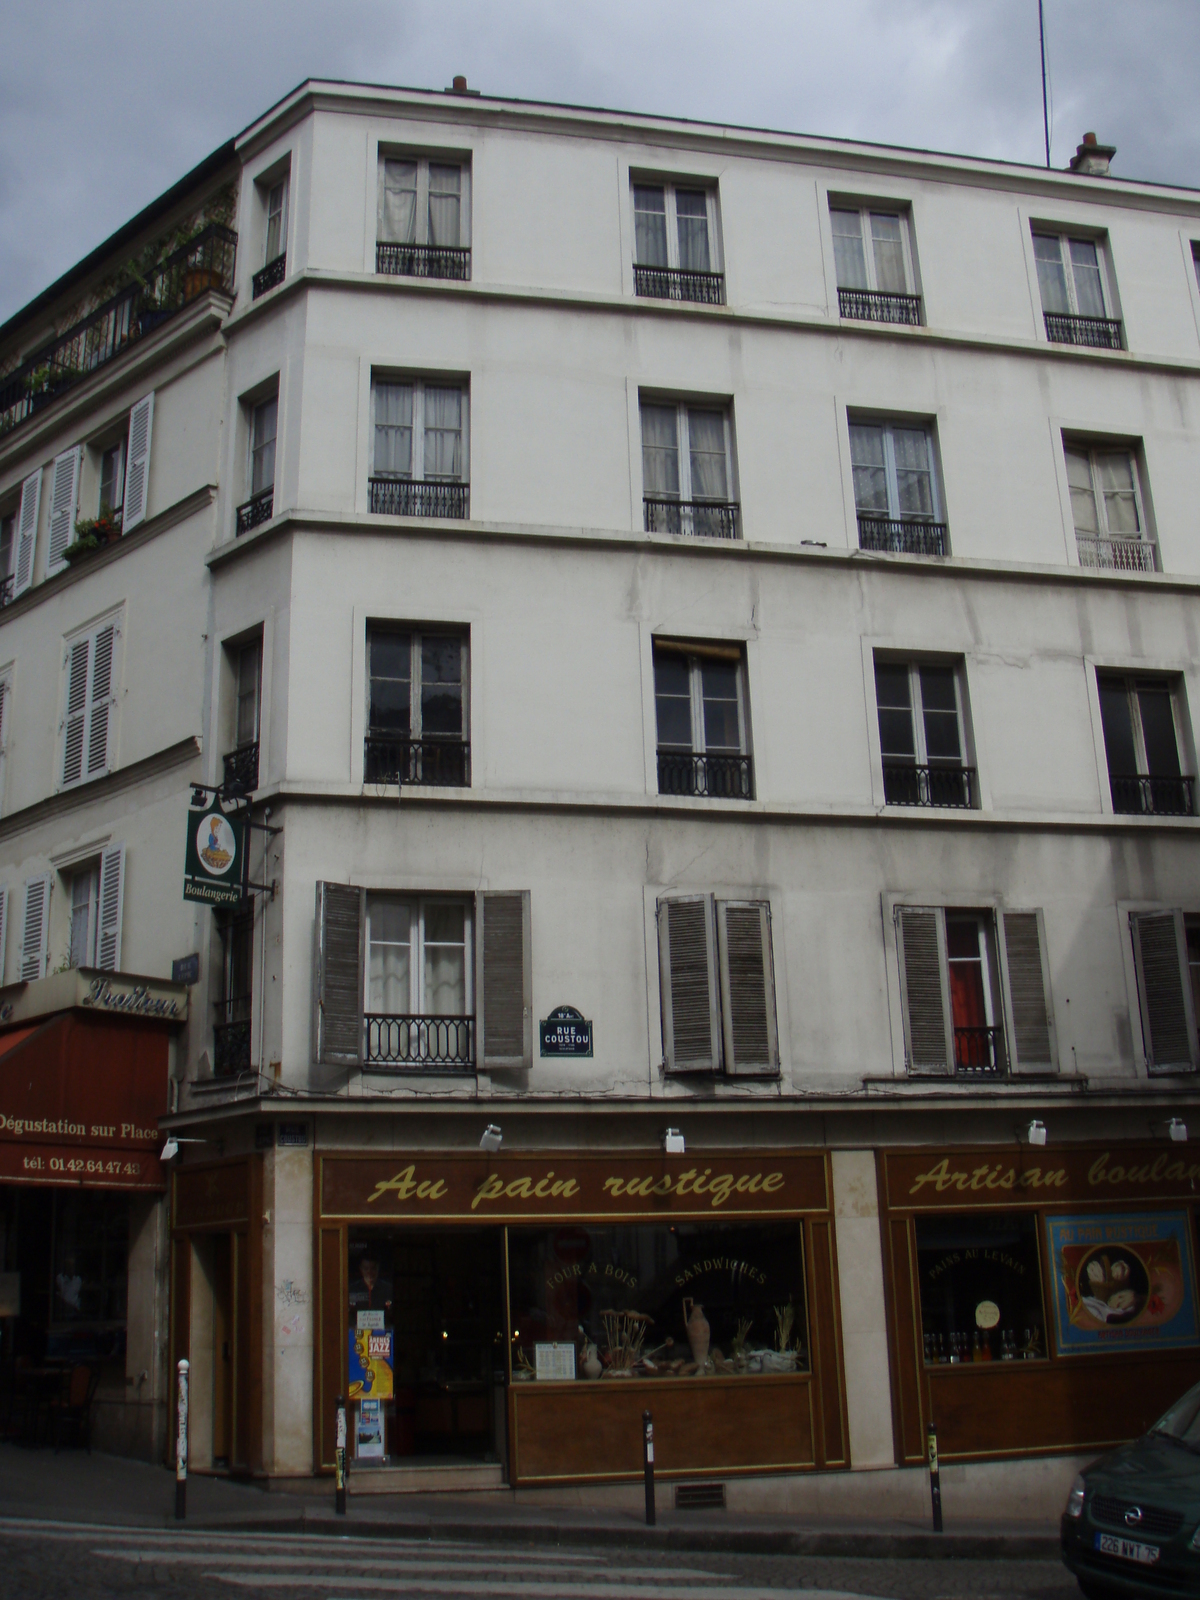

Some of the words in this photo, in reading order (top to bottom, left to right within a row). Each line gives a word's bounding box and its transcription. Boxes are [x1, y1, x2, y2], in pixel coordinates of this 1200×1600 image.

[185, 883, 239, 903] Boulangerie
[545, 1035, 589, 1043] COUSTOU
[557, 1026, 576, 1035] RUE
[0, 1114, 86, 1135] Dégustation
[91, 1123, 116, 1137] sur
[120, 1123, 158, 1140] Place
[23, 1156, 45, 1169] tél:
[366, 1164, 448, 1203] Au
[471, 1172, 583, 1209] pain
[602, 1169, 786, 1206] rustique
[908, 1158, 1070, 1194] Artisan
[546, 1262, 582, 1289] FOUR
[604, 1264, 638, 1288] BOIS
[675, 1256, 767, 1287] SANDWICHES
[929, 1252, 961, 1279] PAINS
[965, 1249, 981, 1261] AU
[984, 1249, 1028, 1276] LEVAIN
[369, 1343, 390, 1353] JAZZ
[1102, 1536, 1119, 1553] 226
[1145, 1546, 1158, 1560] 75
